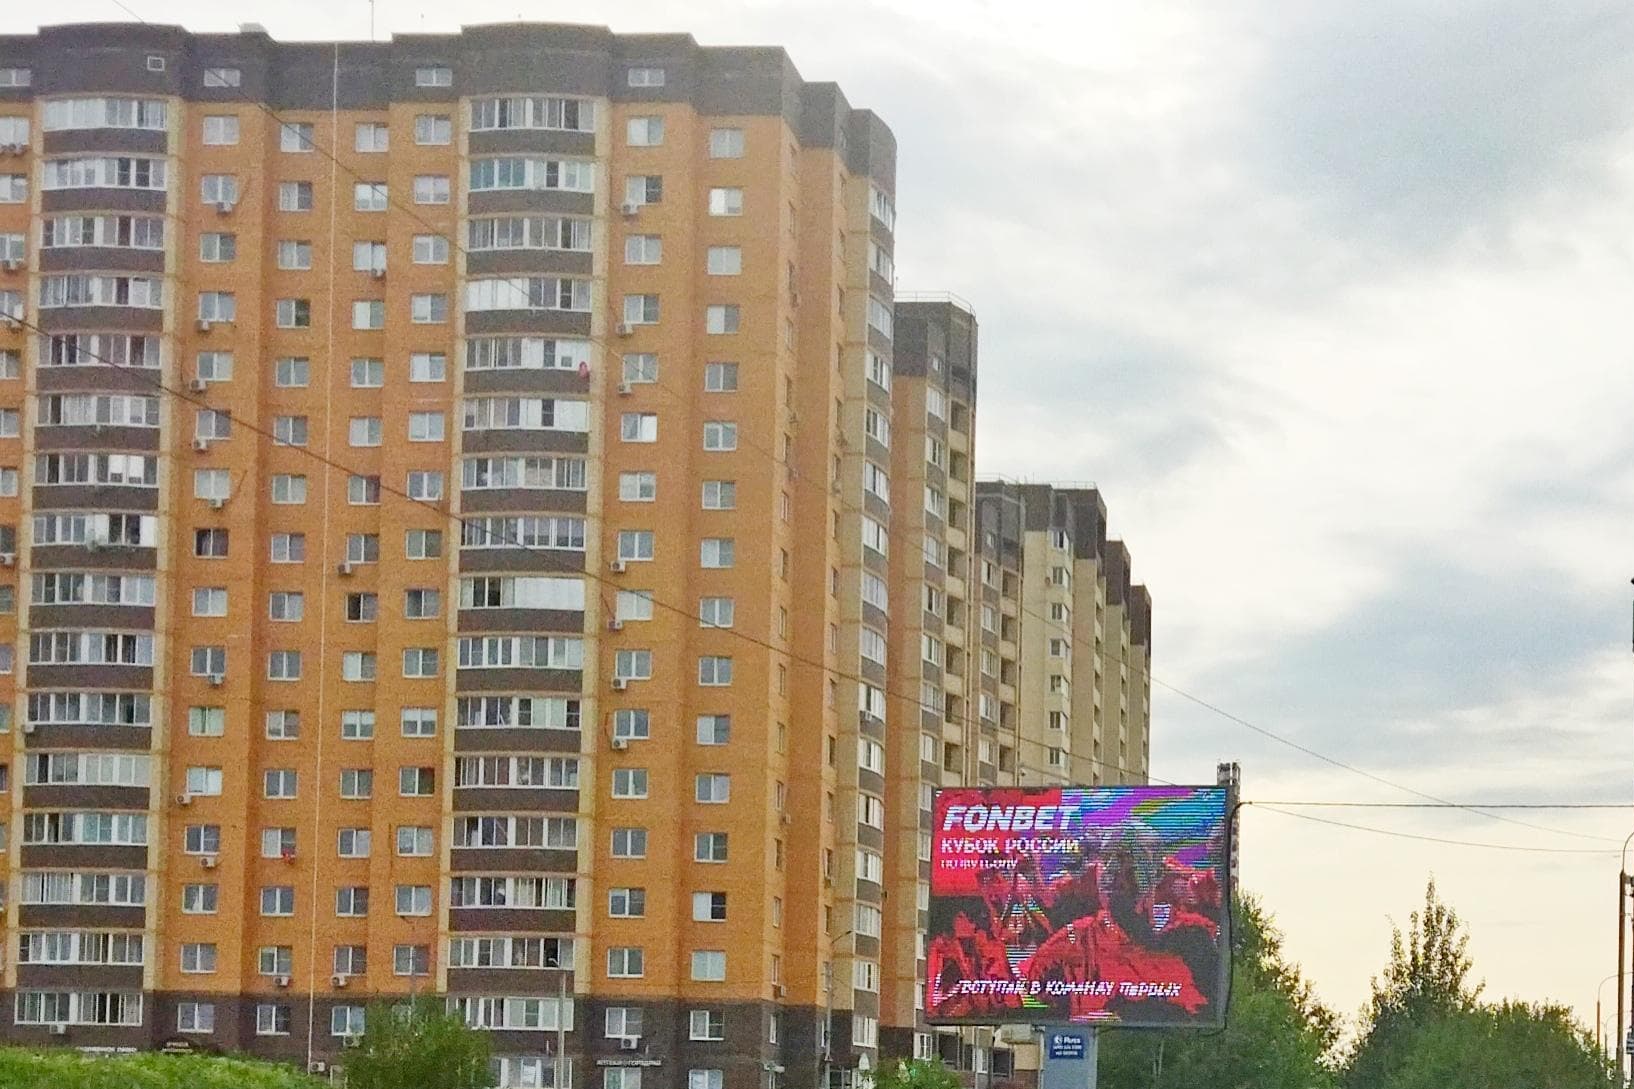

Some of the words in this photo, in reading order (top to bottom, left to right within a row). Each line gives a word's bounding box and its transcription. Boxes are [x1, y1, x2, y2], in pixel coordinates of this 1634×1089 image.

[943, 805, 1080, 832] FONBET
[941, 838, 999, 853] КУБОК
[1005, 838, 1079, 853] РОССИИ
